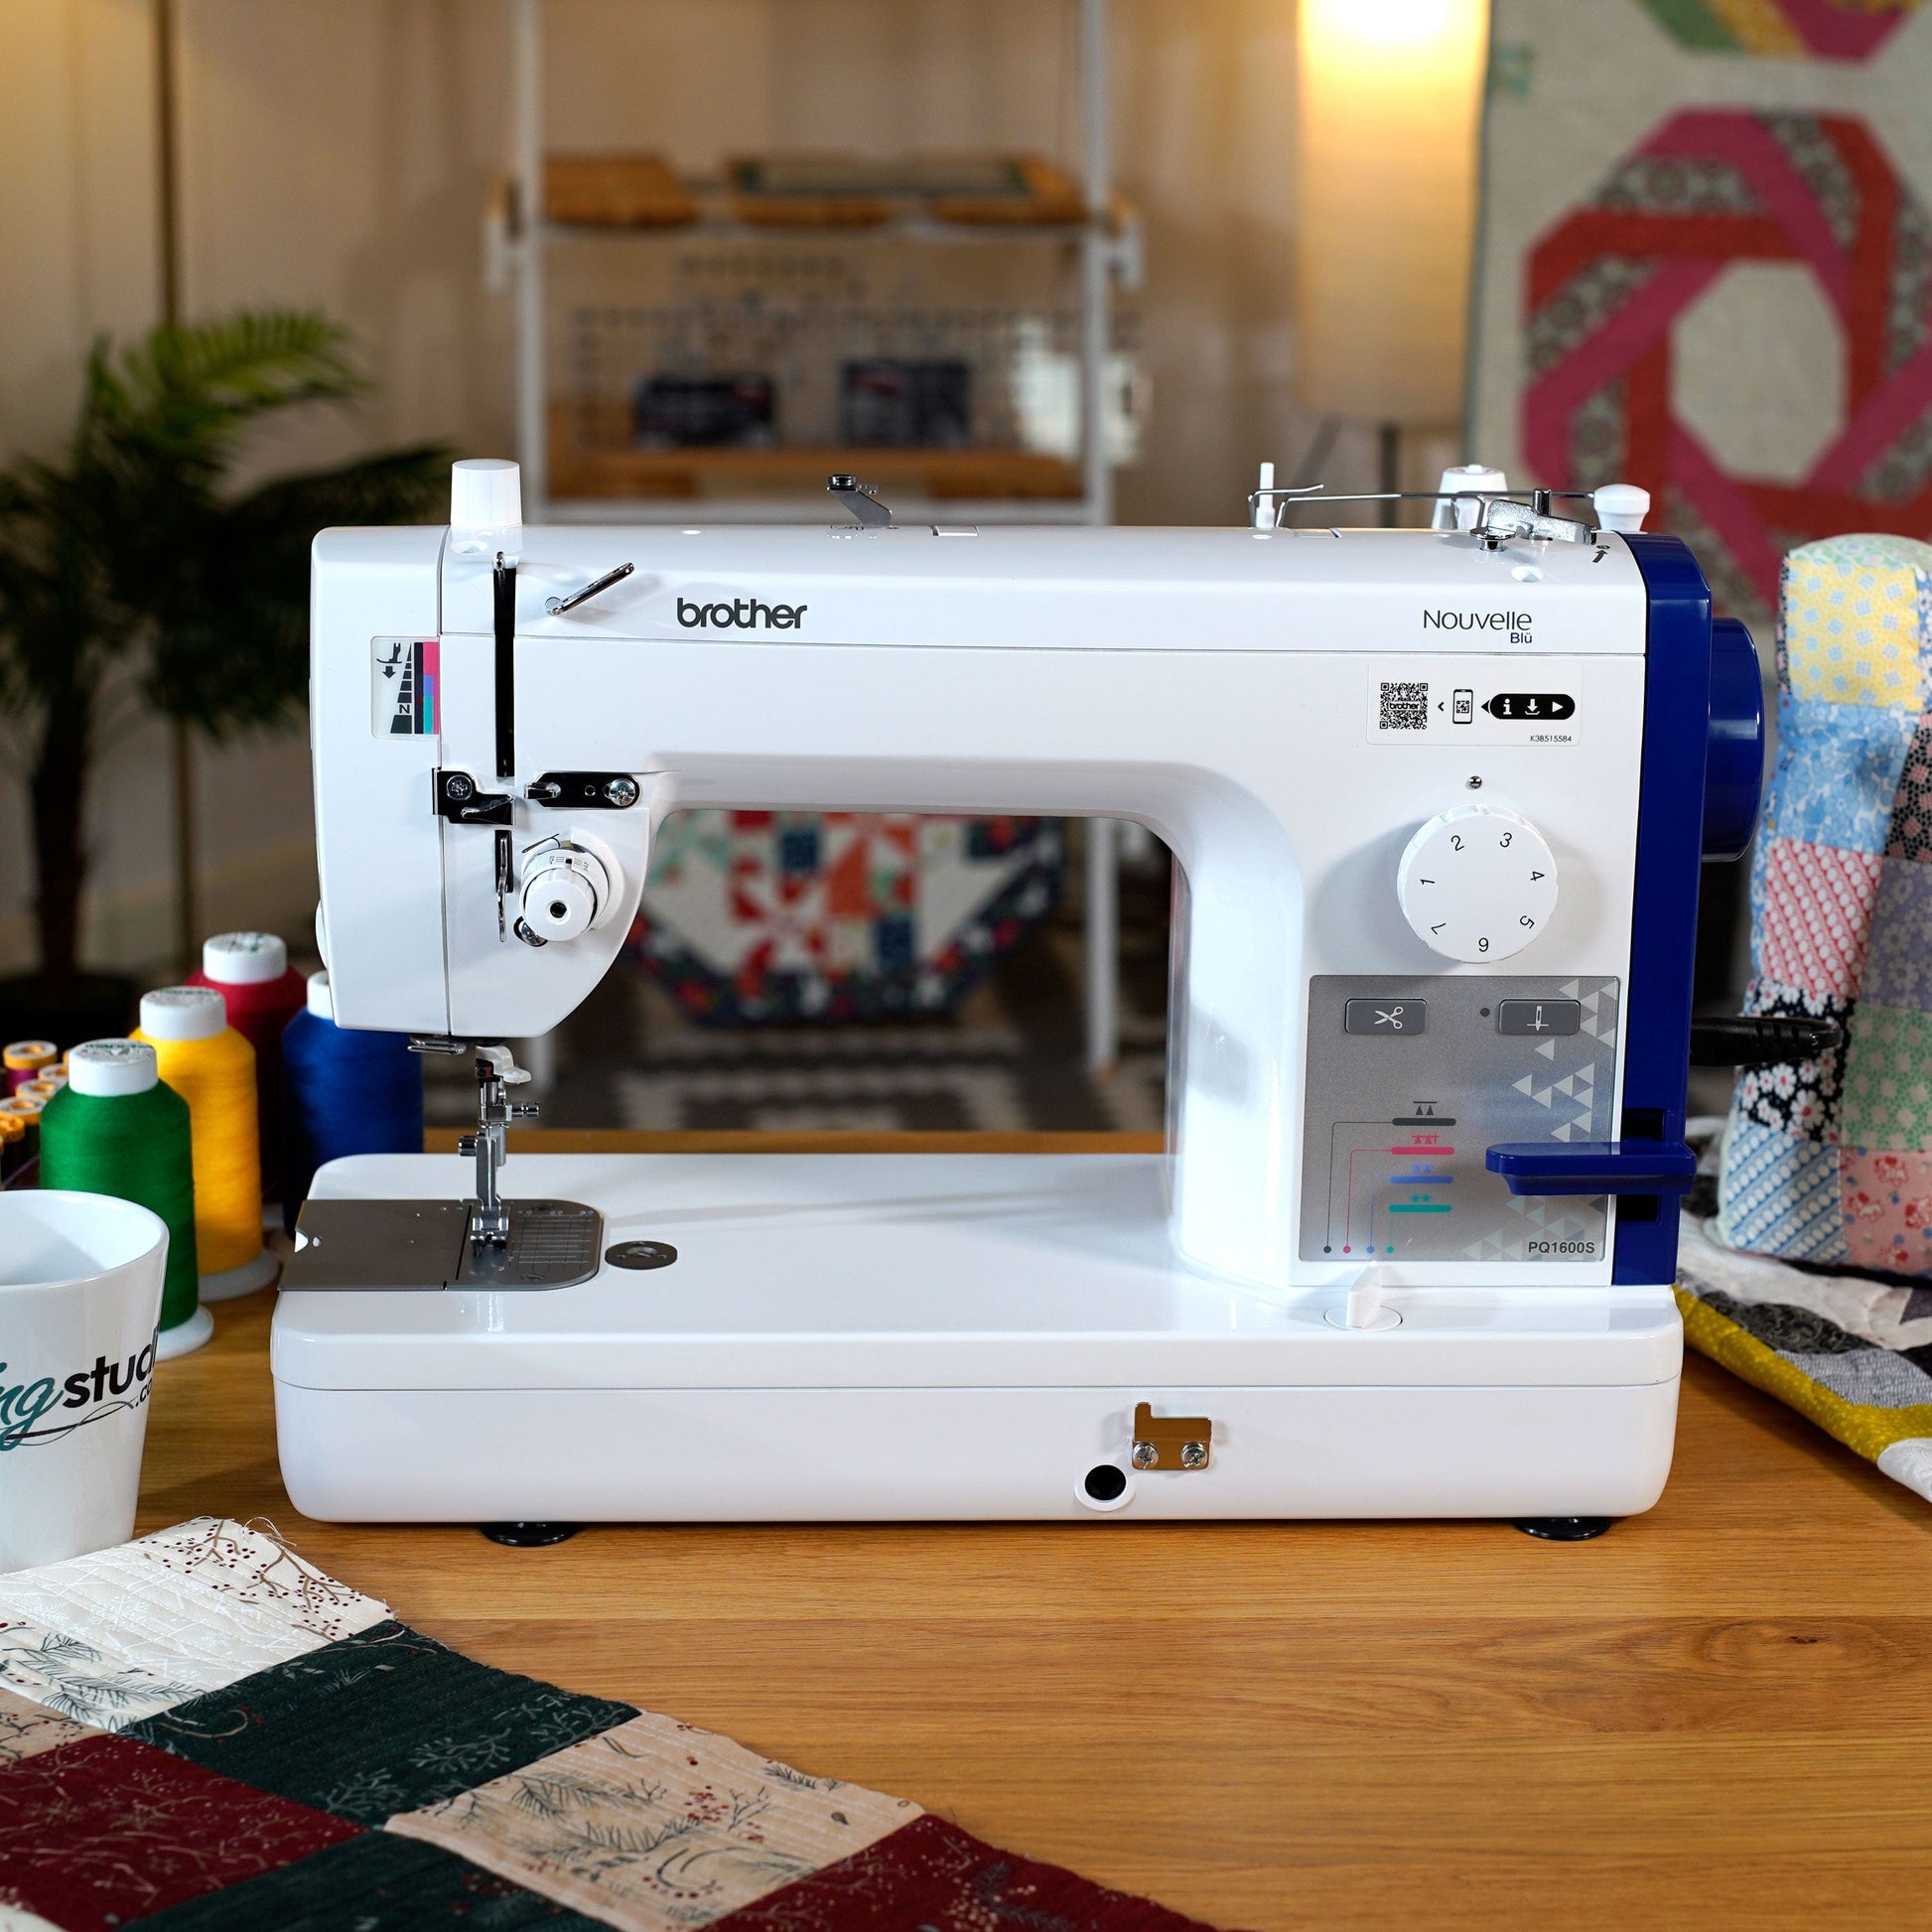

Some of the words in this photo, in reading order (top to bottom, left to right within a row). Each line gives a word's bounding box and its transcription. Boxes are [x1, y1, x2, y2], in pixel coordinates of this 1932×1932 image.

[677, 598, 807, 628] brother
[1424, 610, 1532, 630] Nouvelle
[1510, 632, 1532, 643] Blü
[399, 704, 410, 714] N
[1450, 835, 1464, 851] 2
[1499, 832, 1513, 848] 3
[1530, 871, 1545, 882] 4
[1431, 922, 1447, 935] 7
[1519, 915, 1535, 929] 5
[1529, 1241, 1595, 1254] PQ1600S
